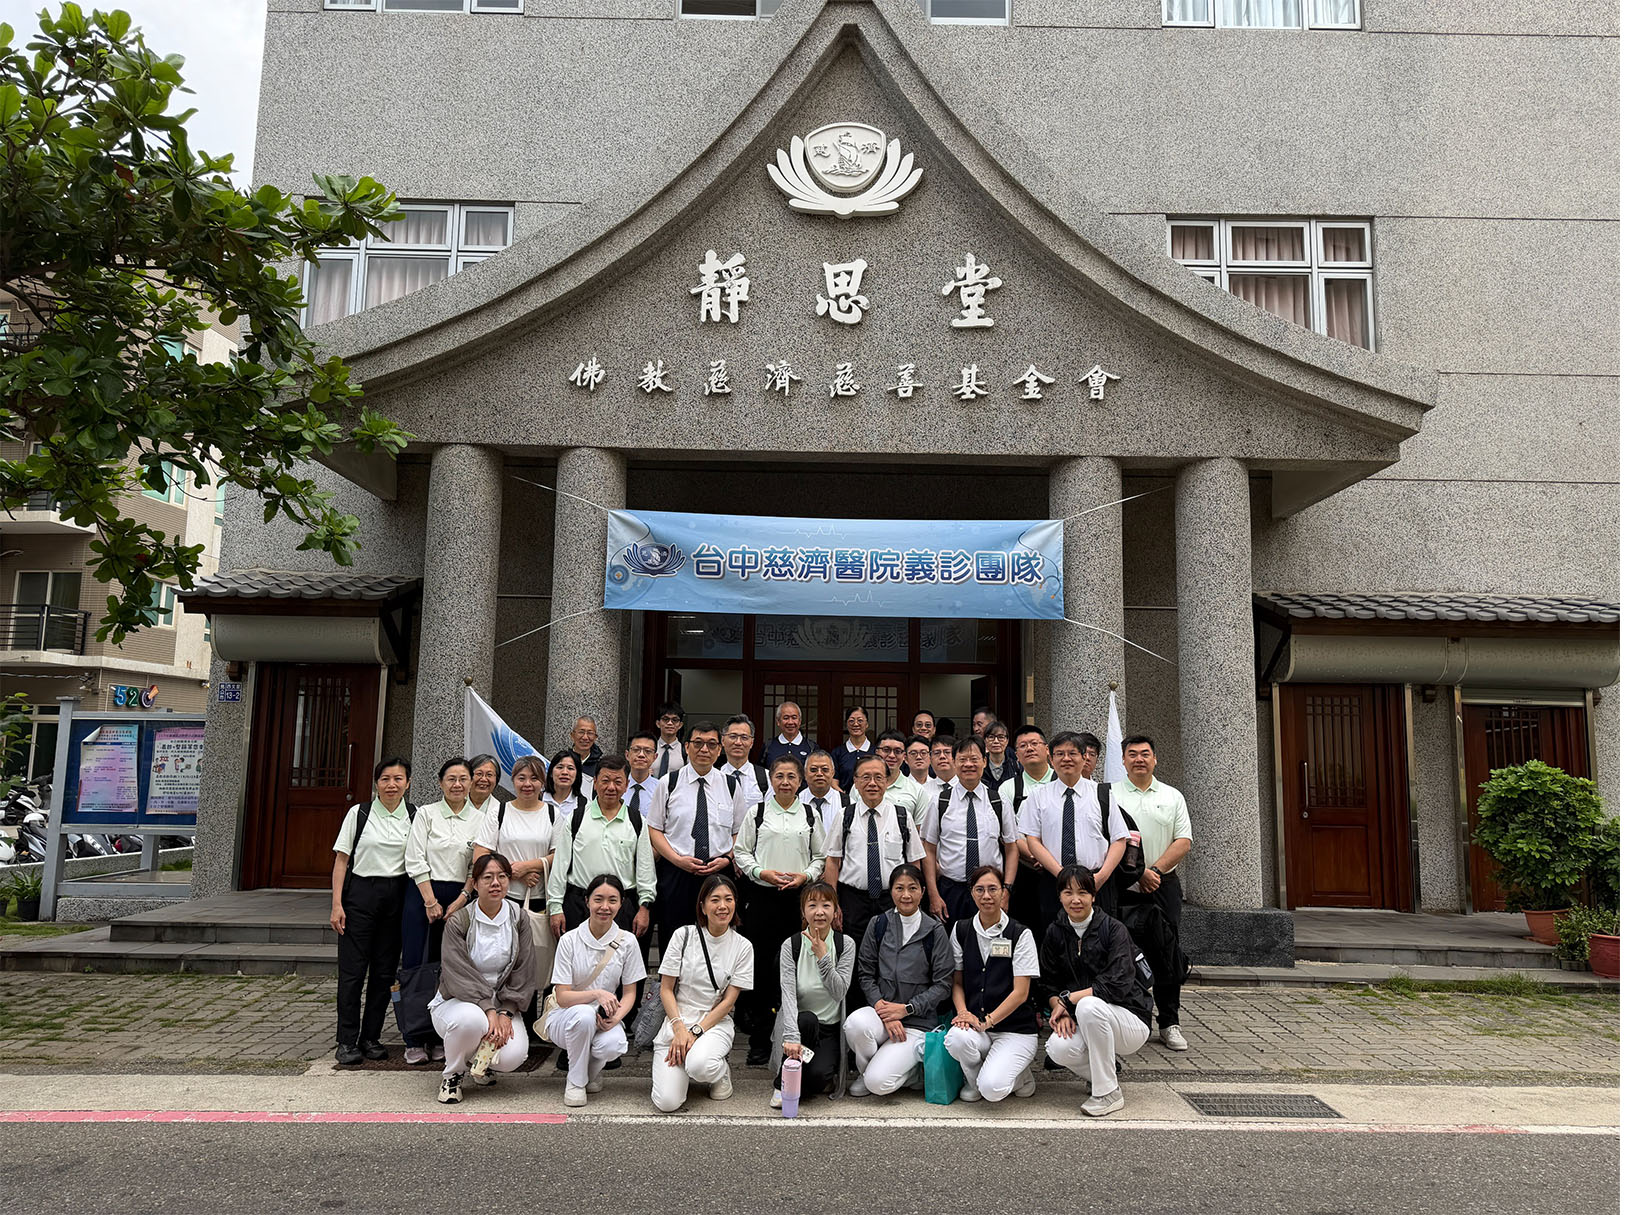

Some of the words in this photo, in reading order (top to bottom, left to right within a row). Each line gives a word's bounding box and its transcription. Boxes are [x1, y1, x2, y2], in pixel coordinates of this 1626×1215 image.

[690, 249, 1003, 329] 靜思堂
[568, 352, 1121, 401] 佛教慈濟慈善基金會
[690, 542, 1045, 586] 台中慈濟醫院義診團隊
[226, 691, 240, 700] 13-2
